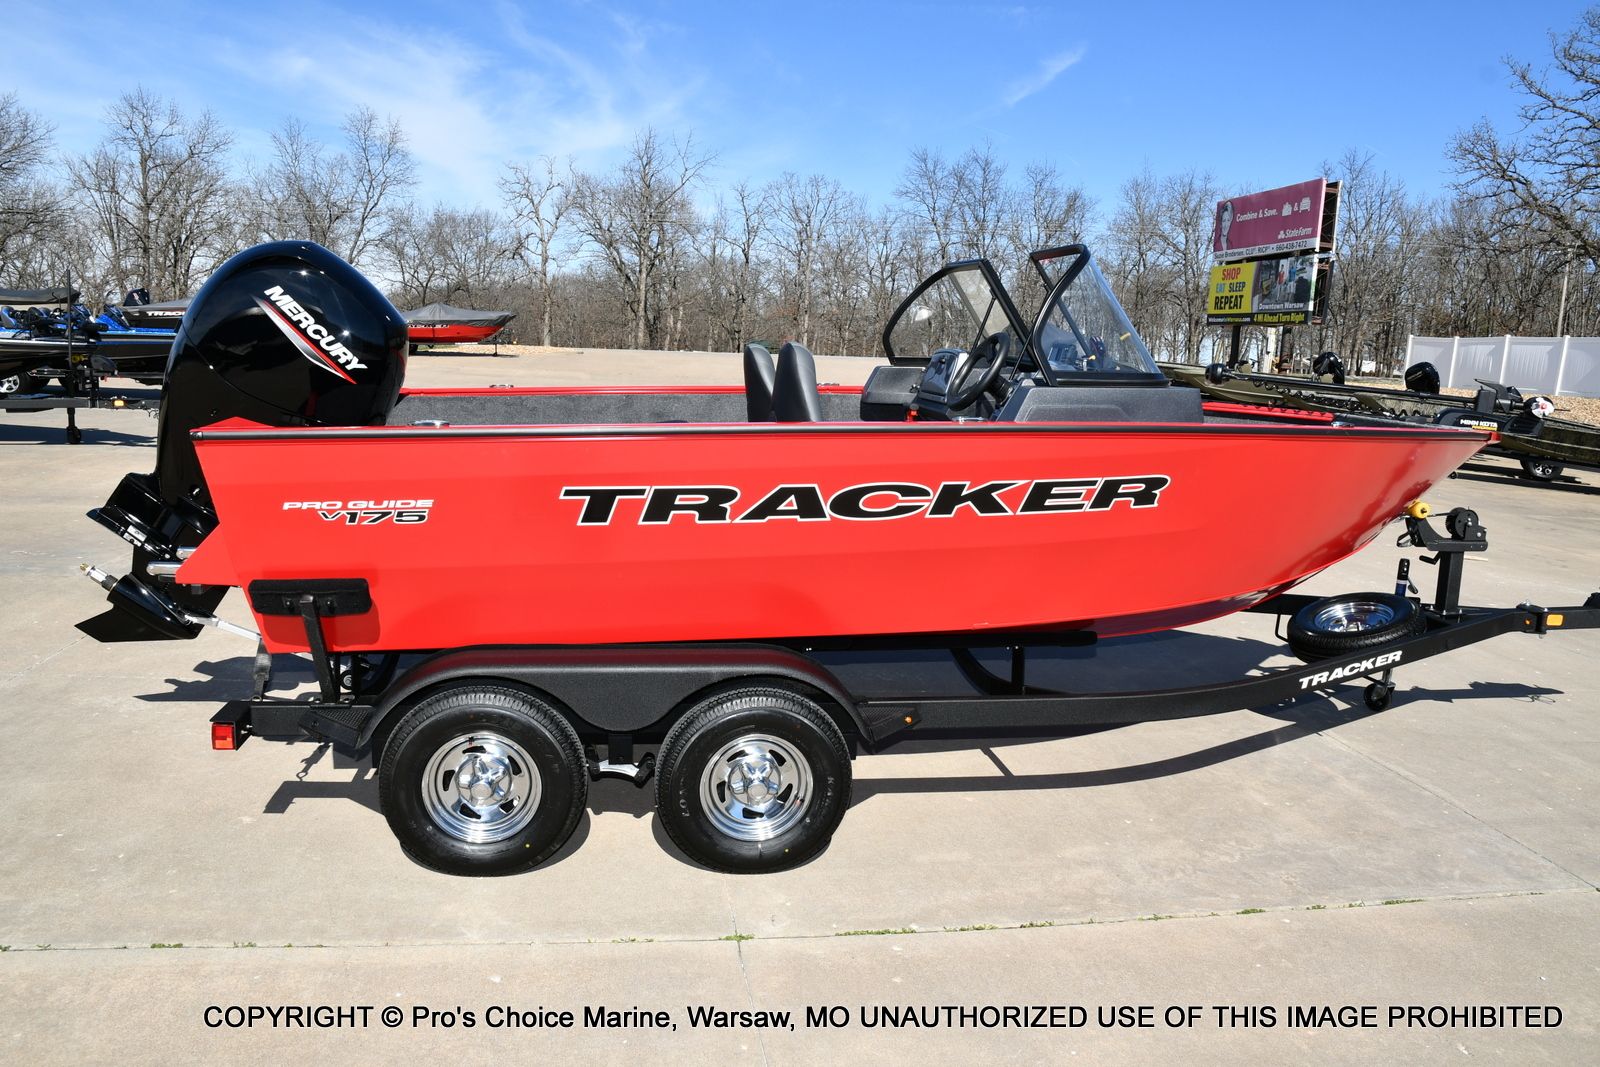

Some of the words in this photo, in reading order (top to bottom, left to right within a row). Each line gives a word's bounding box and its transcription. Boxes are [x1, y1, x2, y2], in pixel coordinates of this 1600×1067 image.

[1236, 208, 1258, 222] Combine
[1259, 209, 1264, 218] &
[1264, 207, 1278, 217] Save.
[1222, 267, 1241, 281] SHOP
[1216, 283, 1225, 293] EAT
[1228, 281, 1246, 293] SLEEP
[1214, 295, 1244, 310] REPEAT
[1285, 302, 1304, 310] Warsaw
[1264, 314, 1279, 322] Ahead
[1280, 313, 1291, 322] Turn
[1291, 312, 1305, 323] Right
[264, 285, 368, 371] MERCURY
[282, 501, 343, 510] PRO
[347, 499, 434, 509] GUIDE
[559, 475, 1171, 526] TRACKER
[317, 508, 430, 526] V175
[1299, 650, 1403, 690] TRACKER
